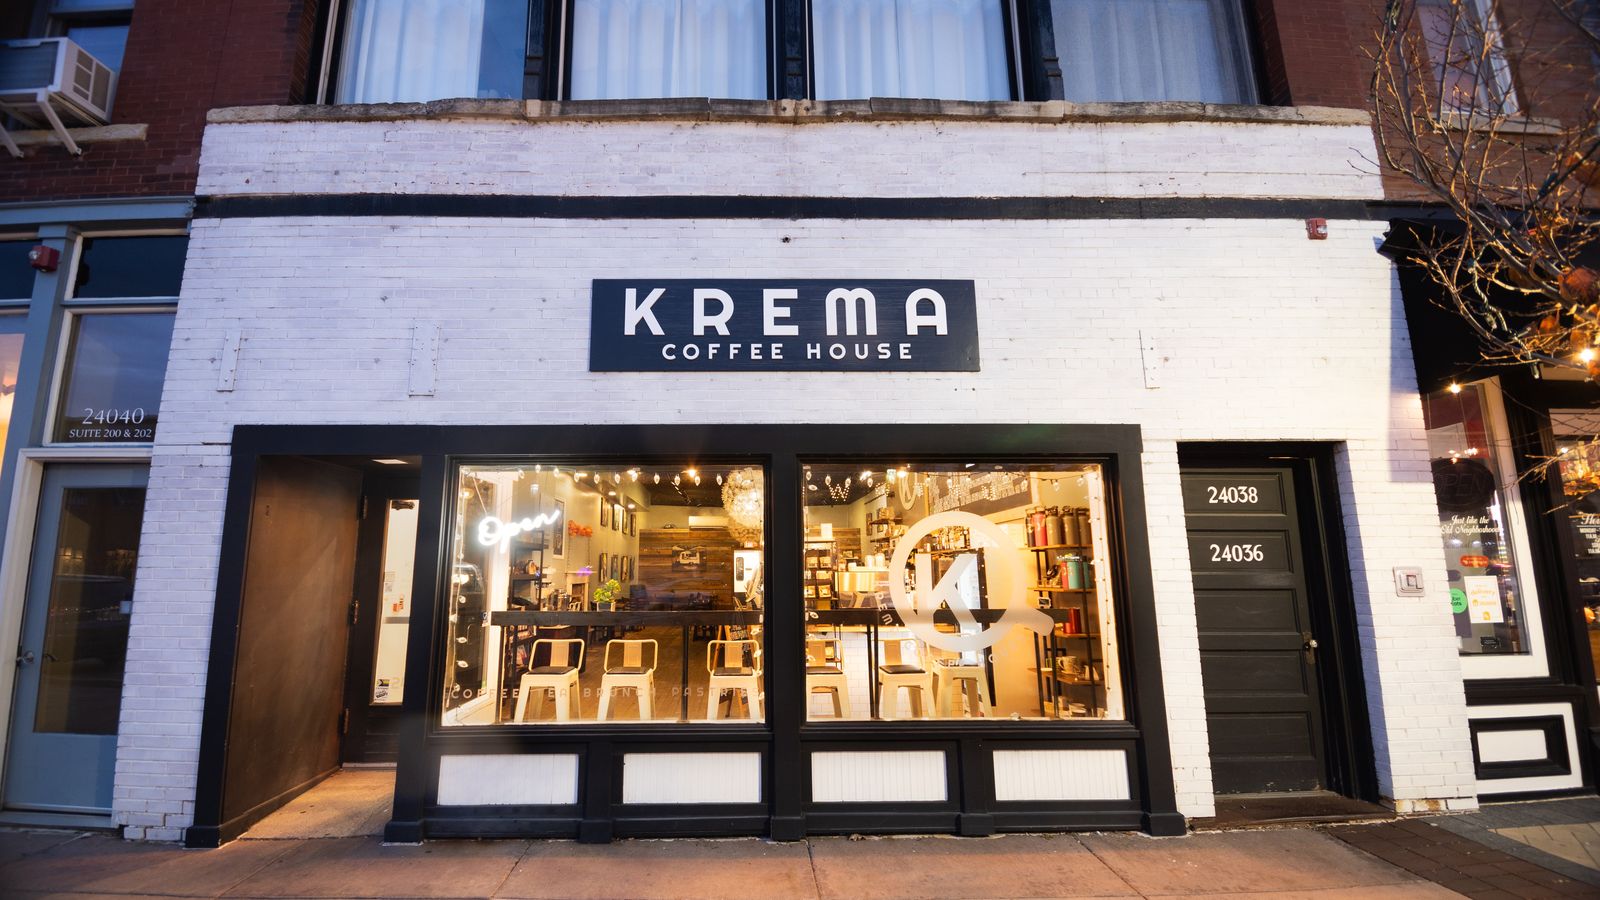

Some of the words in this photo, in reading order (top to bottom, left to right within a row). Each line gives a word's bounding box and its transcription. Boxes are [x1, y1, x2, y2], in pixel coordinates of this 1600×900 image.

[624, 288, 948, 336] KREMA
[662, 343, 784, 360] COFFEE
[807, 343, 912, 360] HOUSE
[82, 408, 145, 424] 24040
[69, 429, 101, 438] SUITE
[104, 429, 121, 438] 200
[124, 429, 131, 438] &
[134, 429, 152, 438] 202
[1207, 486, 1258, 504] 24038
[1451, 515, 1465, 525] Just
[1480, 515, 1489, 524] the
[479, 509, 560, 554] Open
[1209, 544, 1264, 562] 24036
[451, 688, 520, 699] COFFEE
[583, 687, 656, 698] BRUNCH
